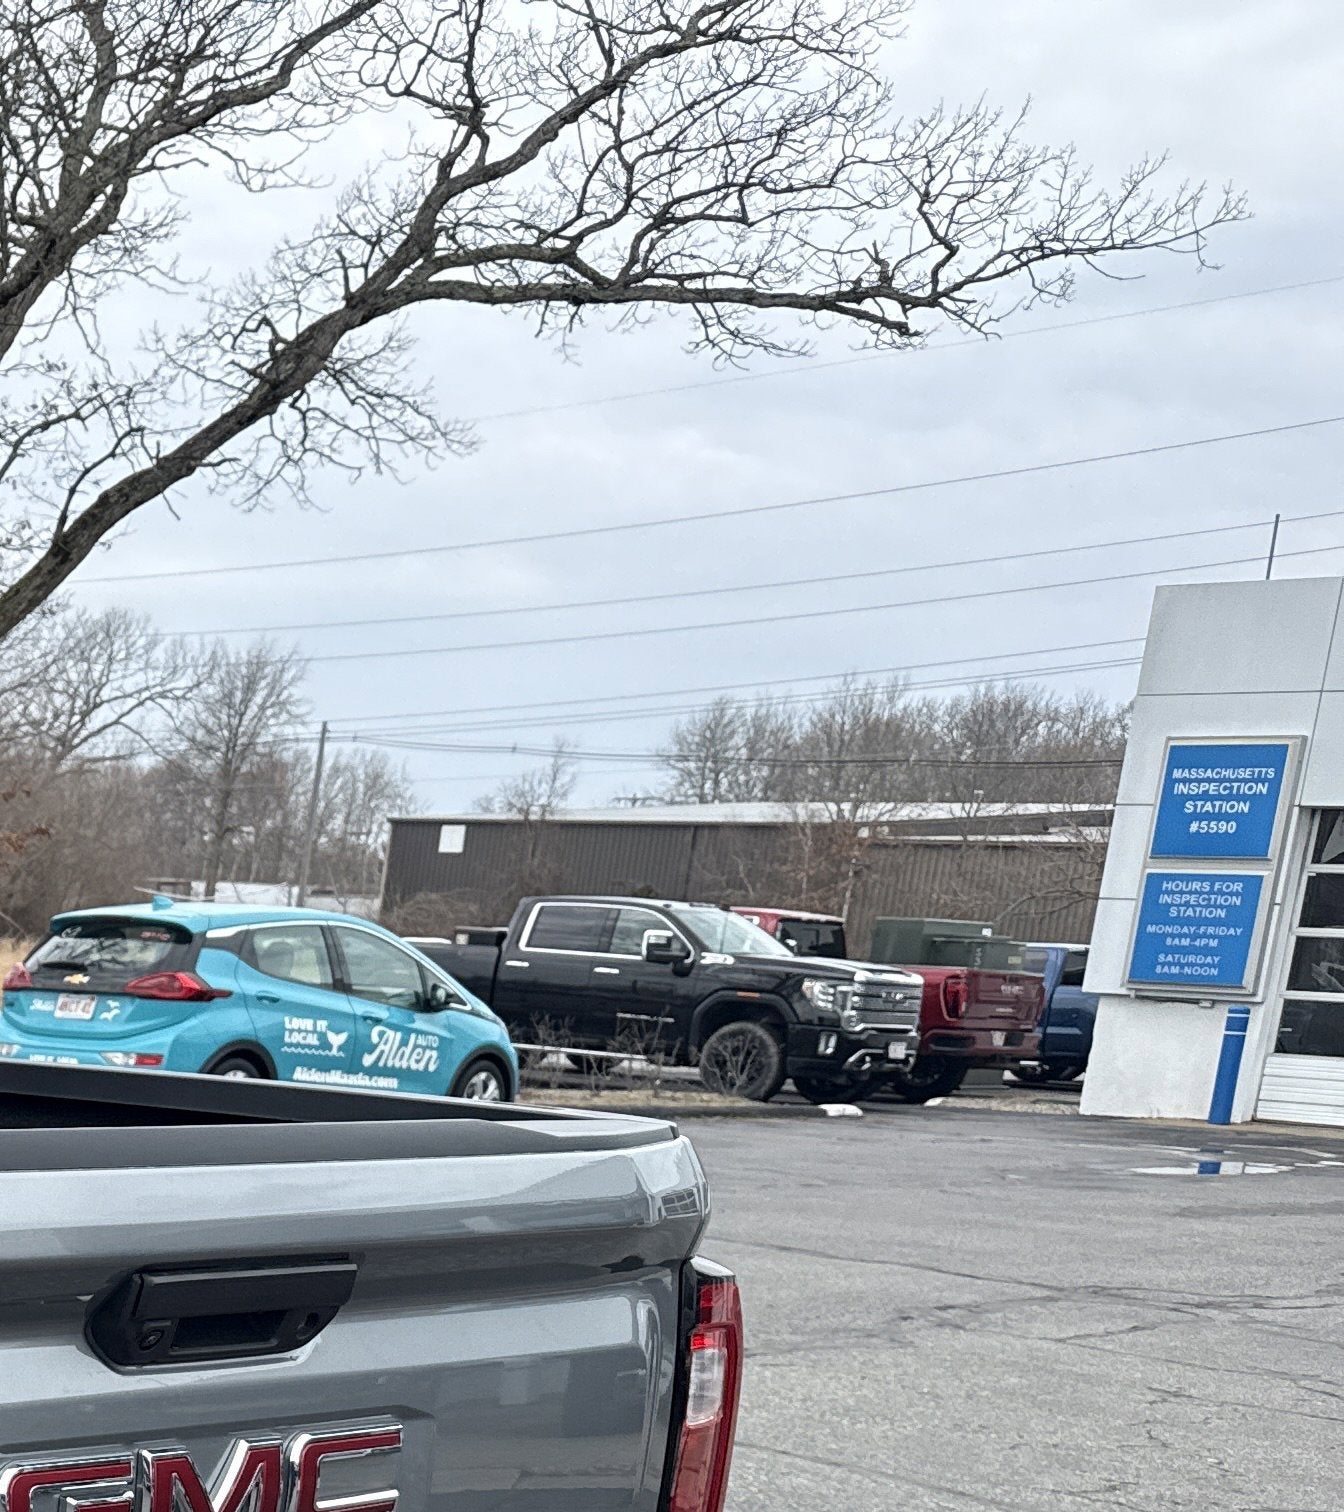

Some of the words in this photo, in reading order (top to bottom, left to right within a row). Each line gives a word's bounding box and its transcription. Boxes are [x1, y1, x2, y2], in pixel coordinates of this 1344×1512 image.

[1172, 767, 1275, 779] MASSACHUSETTS
[1173, 782, 1269, 795] INSPECTION
[1183, 800, 1250, 814] STATION
[1189, 820, 1237, 834] #5590
[1162, 880, 1211, 892] HOURS
[1214, 881, 1244, 893] FOR
[1158, 893, 1242, 906] INSPECTION
[1168, 906, 1227, 918] STATION
[1146, 924, 1243, 936] MONDAY-FRIDAY
[1165, 937, 1219, 947] 8AM-4PM
[1157, 953, 1221, 965] SATURDAY
[1155, 965, 1219, 976] 8AM-NOON
[283, 1016, 314, 1031] LOVE
[316, 1019, 328, 1032] IT
[284, 1030, 320, 1046] LOCAL
[416, 1033, 440, 1048] AUTO
[362, 1025, 440, 1073] Alden
